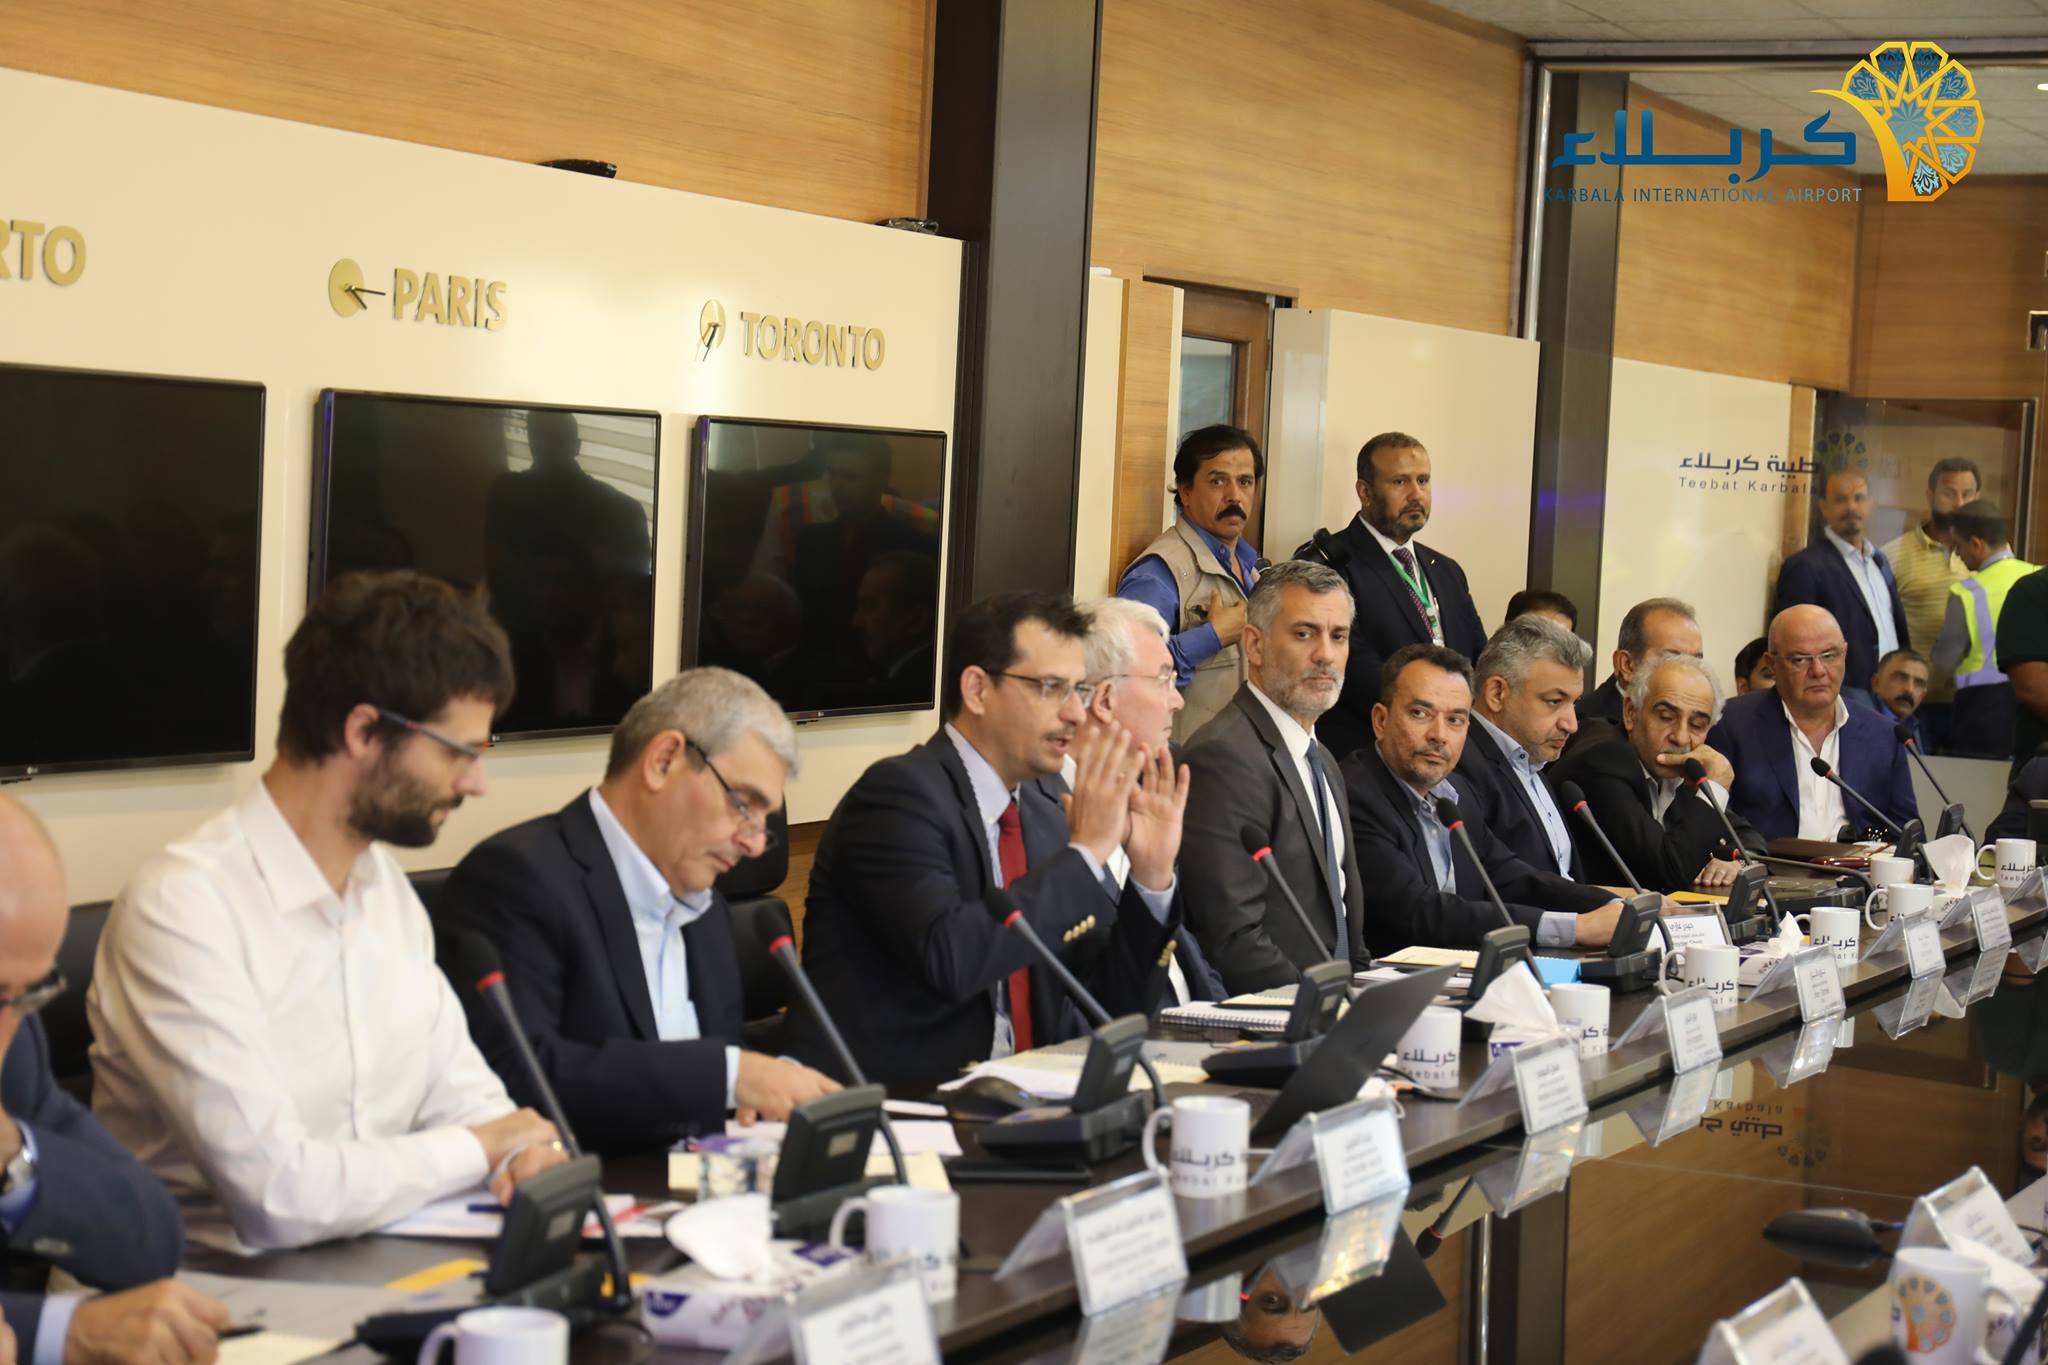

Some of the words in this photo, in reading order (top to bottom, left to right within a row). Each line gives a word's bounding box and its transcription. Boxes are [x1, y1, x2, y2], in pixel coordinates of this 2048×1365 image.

[393, 267, 508, 332] PARIS
[740, 311, 886, 371] TORONTO
[1680, 451, 1759, 475] كربلاء
[1767, 455, 1820, 479] طيبة
[1679, 477, 1737, 490] Teebat
